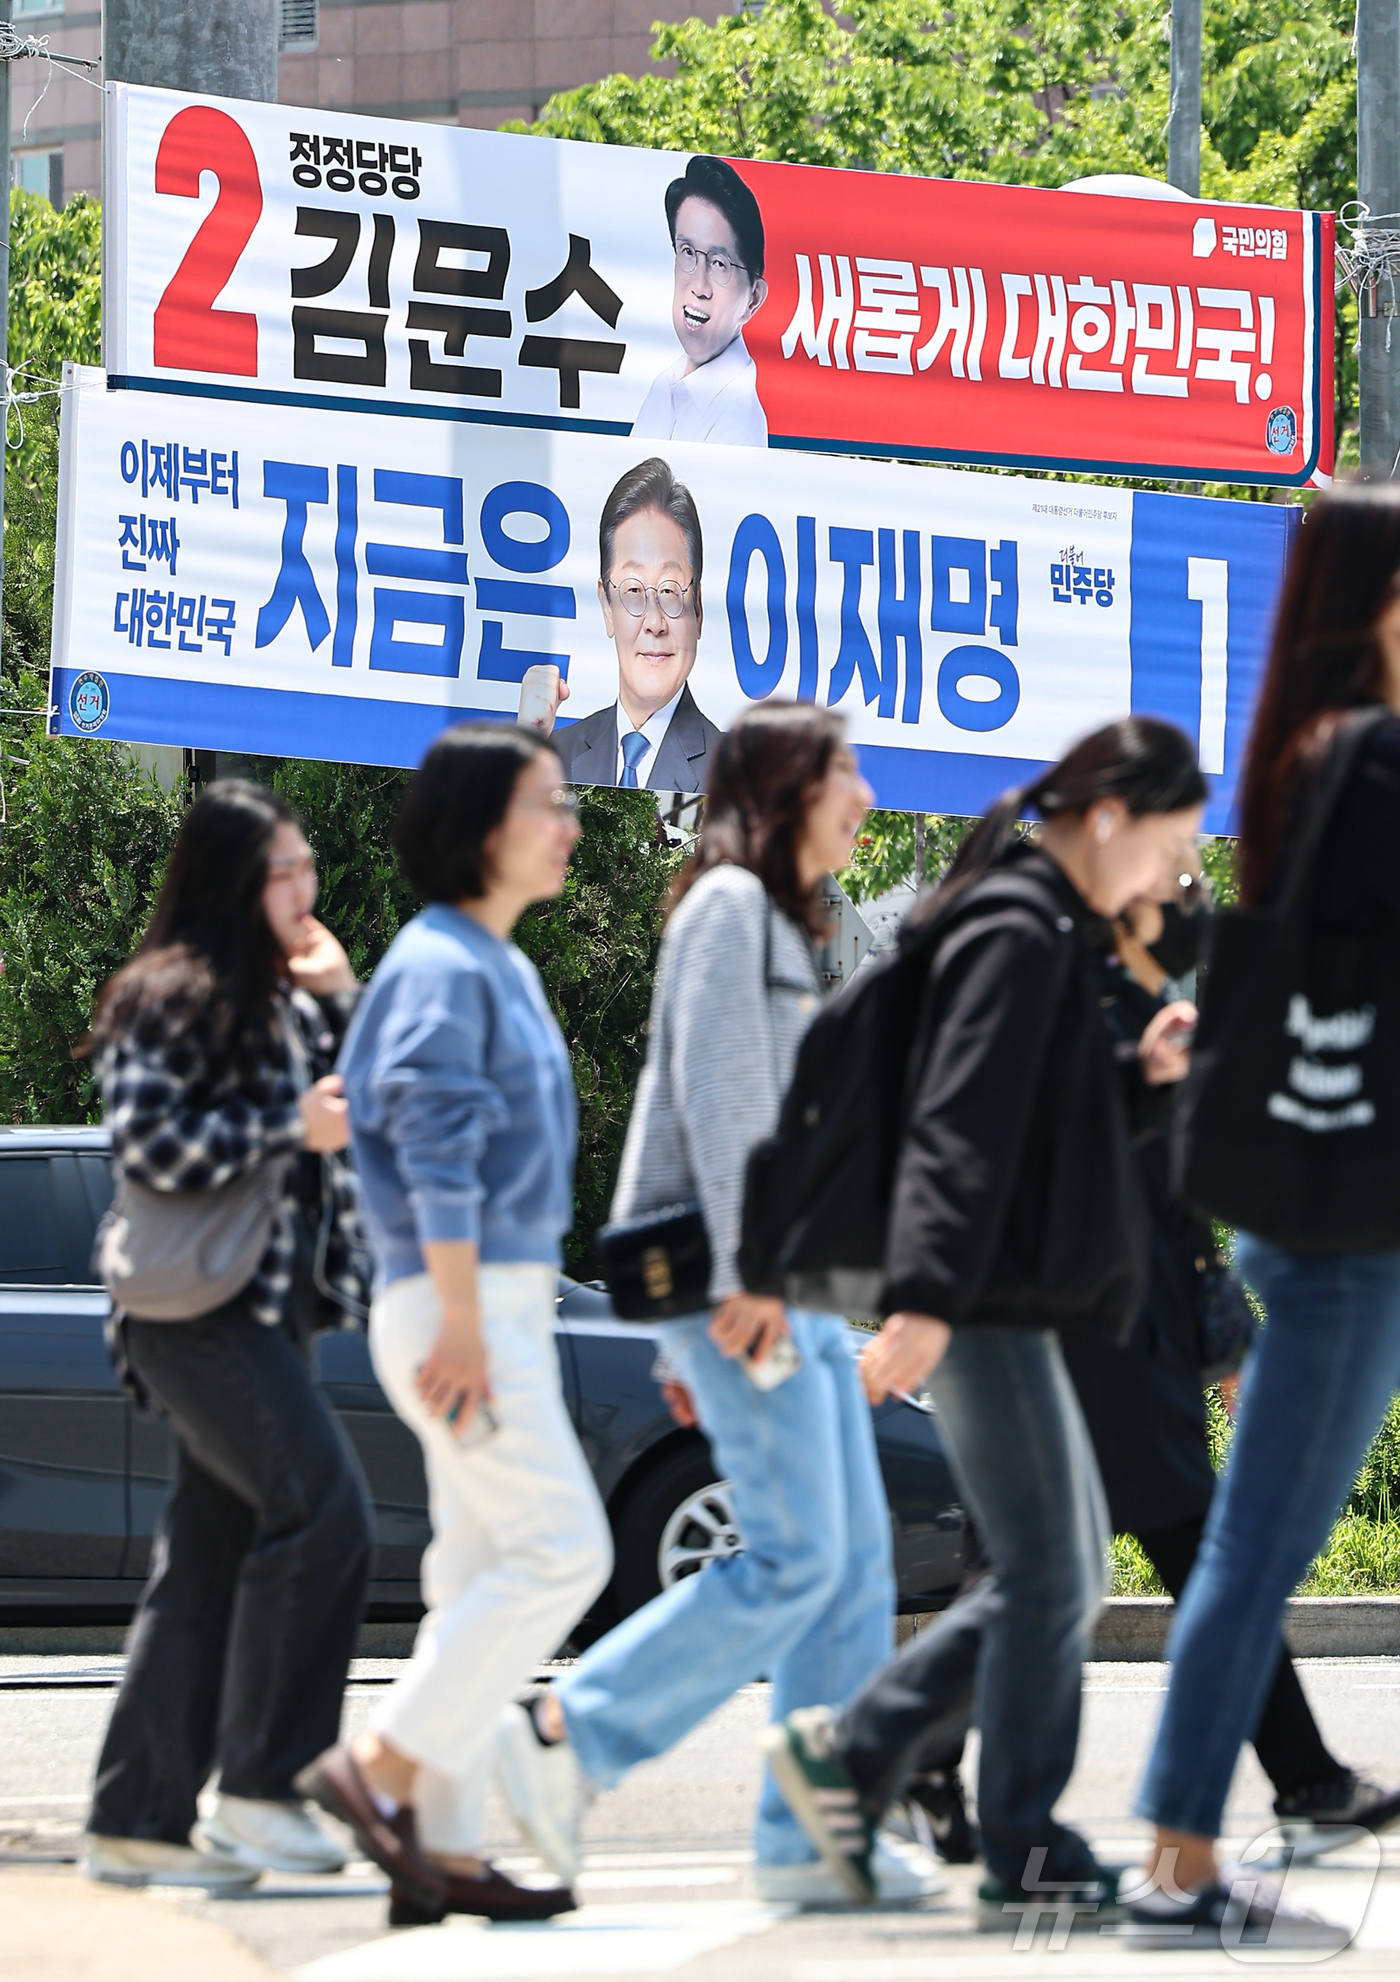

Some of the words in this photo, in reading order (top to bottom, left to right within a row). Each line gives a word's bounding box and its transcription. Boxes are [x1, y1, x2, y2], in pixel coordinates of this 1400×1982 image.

[289, 132, 422, 200] 정정당당
[154, 105, 263, 377] 2
[1222, 226, 1287, 260] 국민의힘
[291, 205, 626, 409] 김문수
[781, 253, 987, 381] 새롭게
[998, 272, 1276, 405] 대한민국!
[1272, 424, 1289, 443] 선거
[120, 438, 239, 509] 이제부터
[118, 513, 180, 576] 진짜
[1032, 503, 1048, 514] 제21대
[1048, 505, 1073, 517] 대통령선거
[1073, 507, 1102, 520] 더불어민주당
[1050, 563, 1115, 608] 민주당
[1059, 544, 1084, 567] 더불어
[113, 588, 236, 656] 대한민국
[256, 459, 576, 683] 지금은
[726, 513, 1020, 732] 이재명
[1187, 556, 1228, 775] 1
[77, 693, 100, 711] 선거
